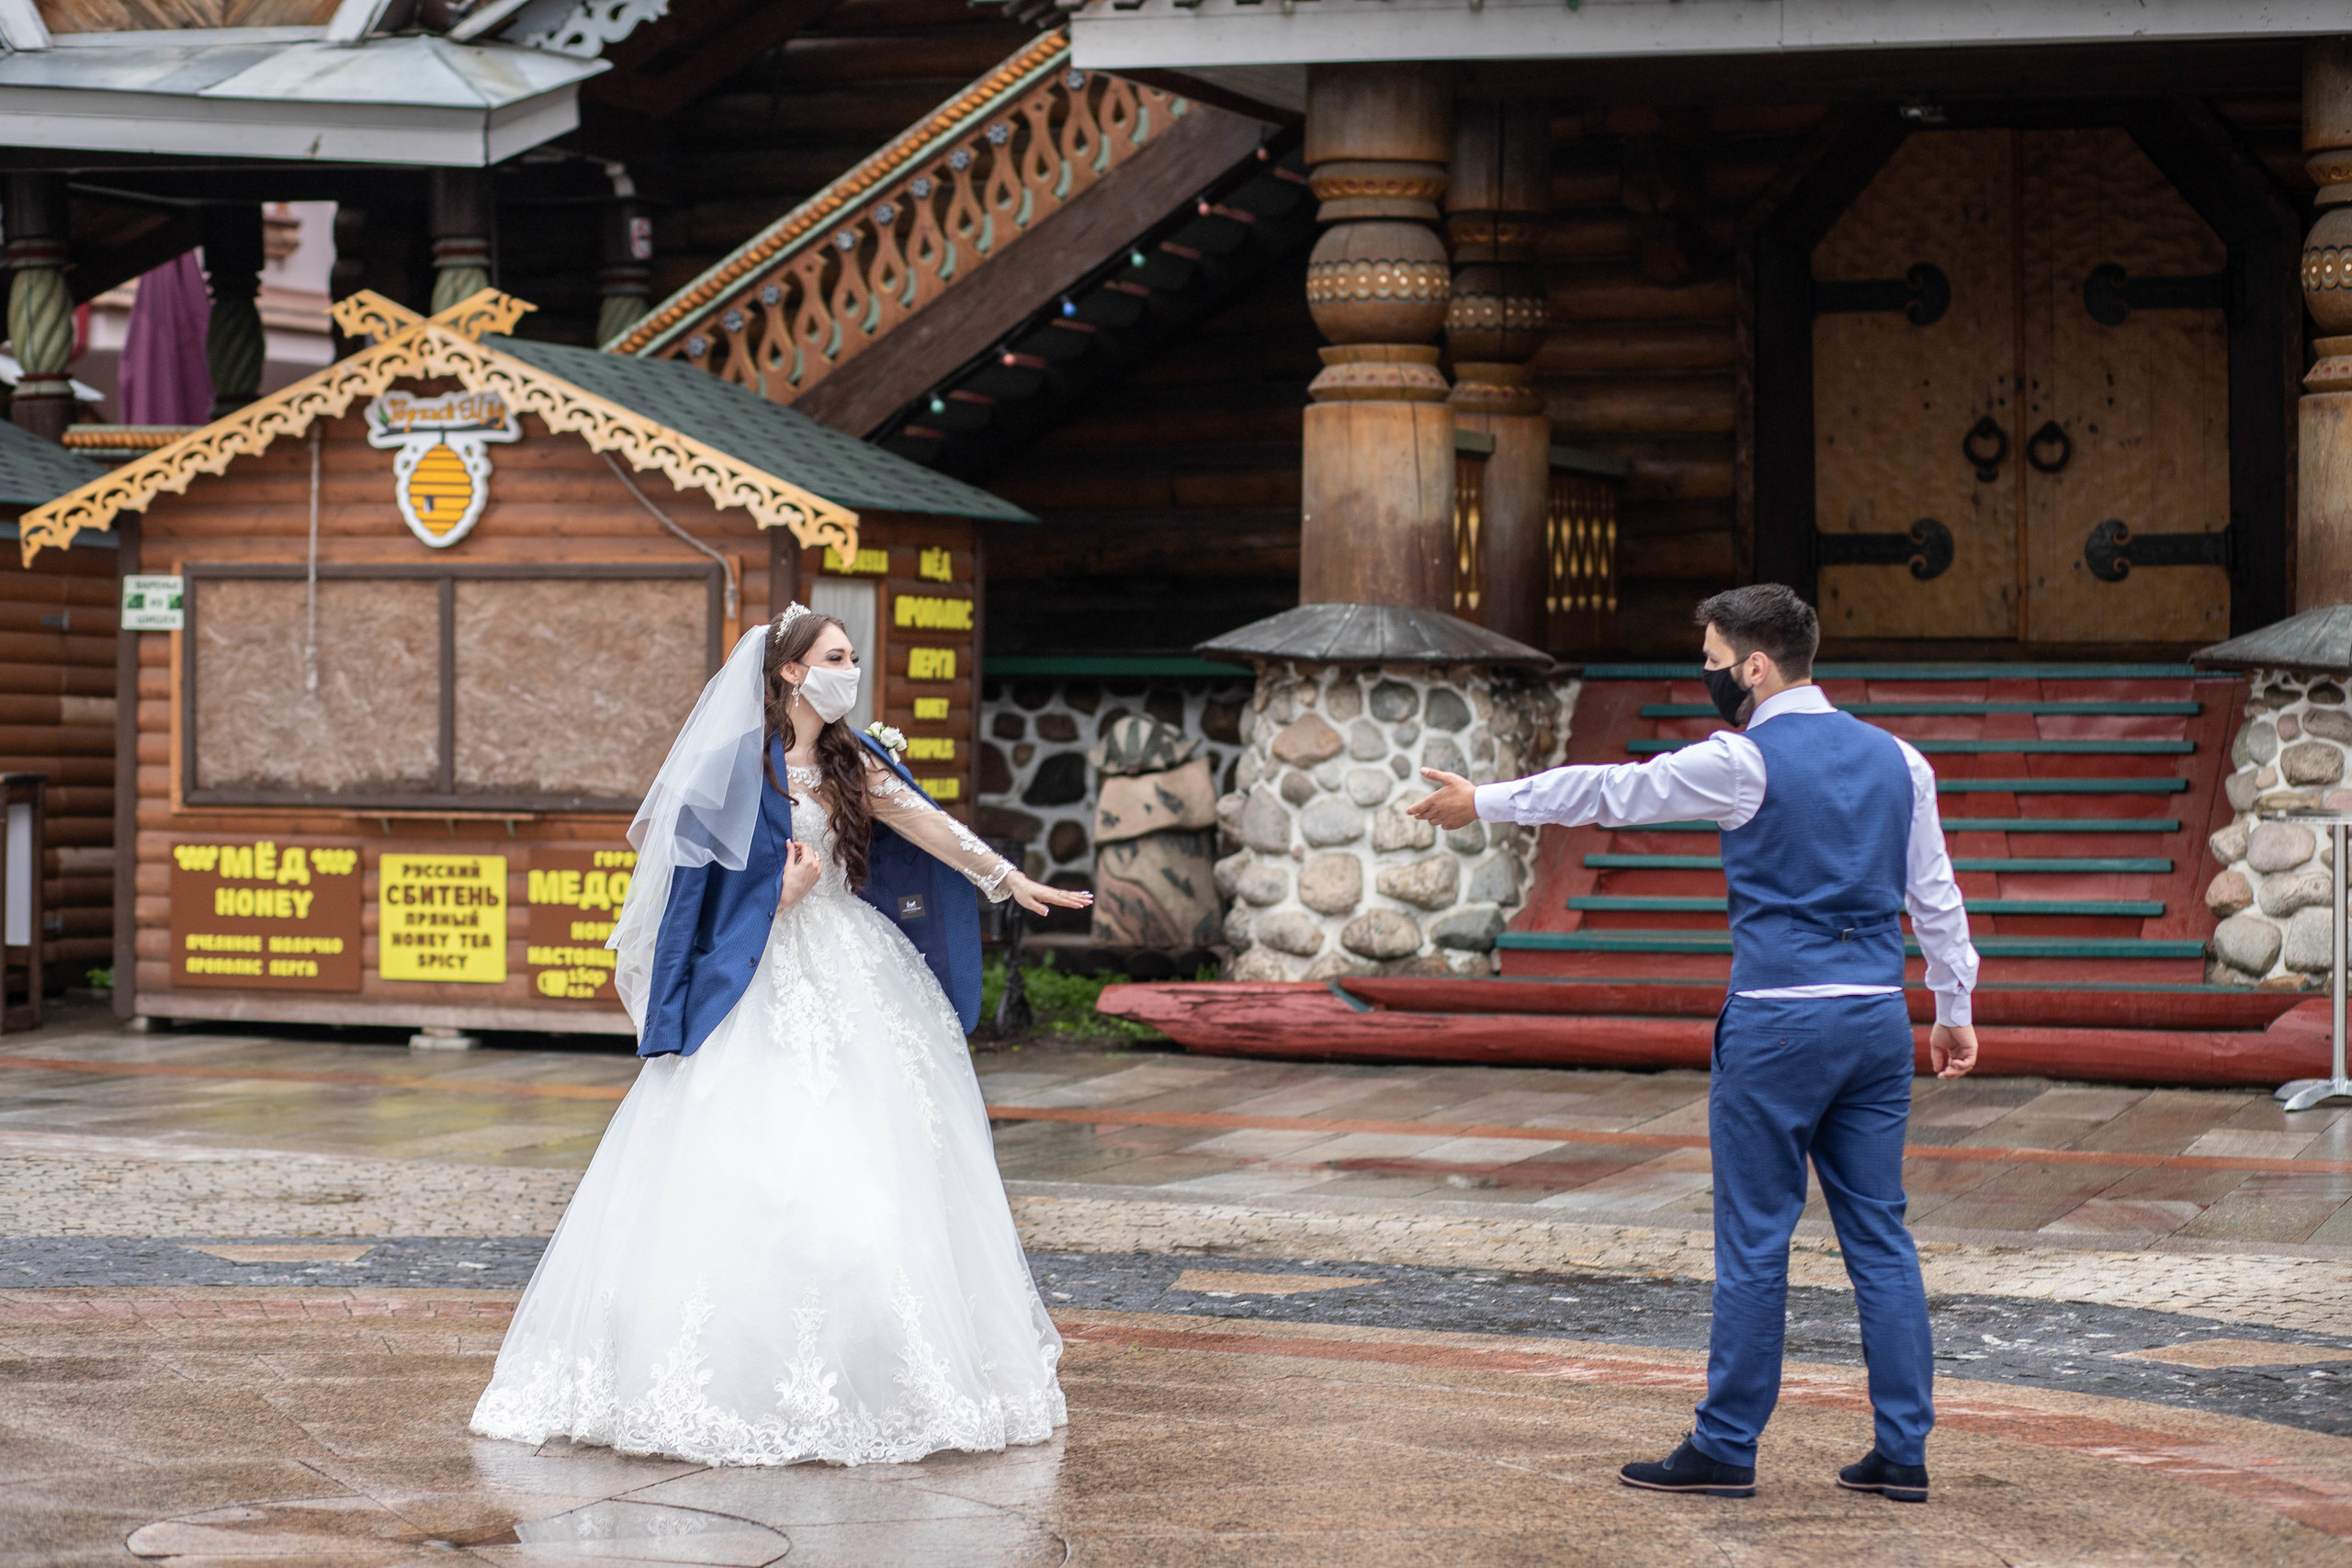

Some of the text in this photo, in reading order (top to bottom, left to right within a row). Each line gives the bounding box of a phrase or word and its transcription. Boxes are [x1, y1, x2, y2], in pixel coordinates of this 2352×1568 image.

[220, 840, 311, 886] МЁД
[402, 860, 480, 878] РУССКИЙ
[594, 851, 639, 868] ГОРЯ
[387, 885, 499, 907] СБИТЕНЬ
[527, 869, 632, 911] МЕДО
[215, 887, 313, 919] HONEY
[405, 910, 479, 927] ПРЯНЫЙ
[186, 933, 345, 954] ПЧЕЛИНОЕ МОЛОЧКО
[392, 932, 491, 948] HONEY TEA
[186, 956, 318, 977] ПРОПОЛИС ПЕРГА
[418, 953, 468, 969] SPICY
[527, 946, 617, 970] НАСТОЯЩ
